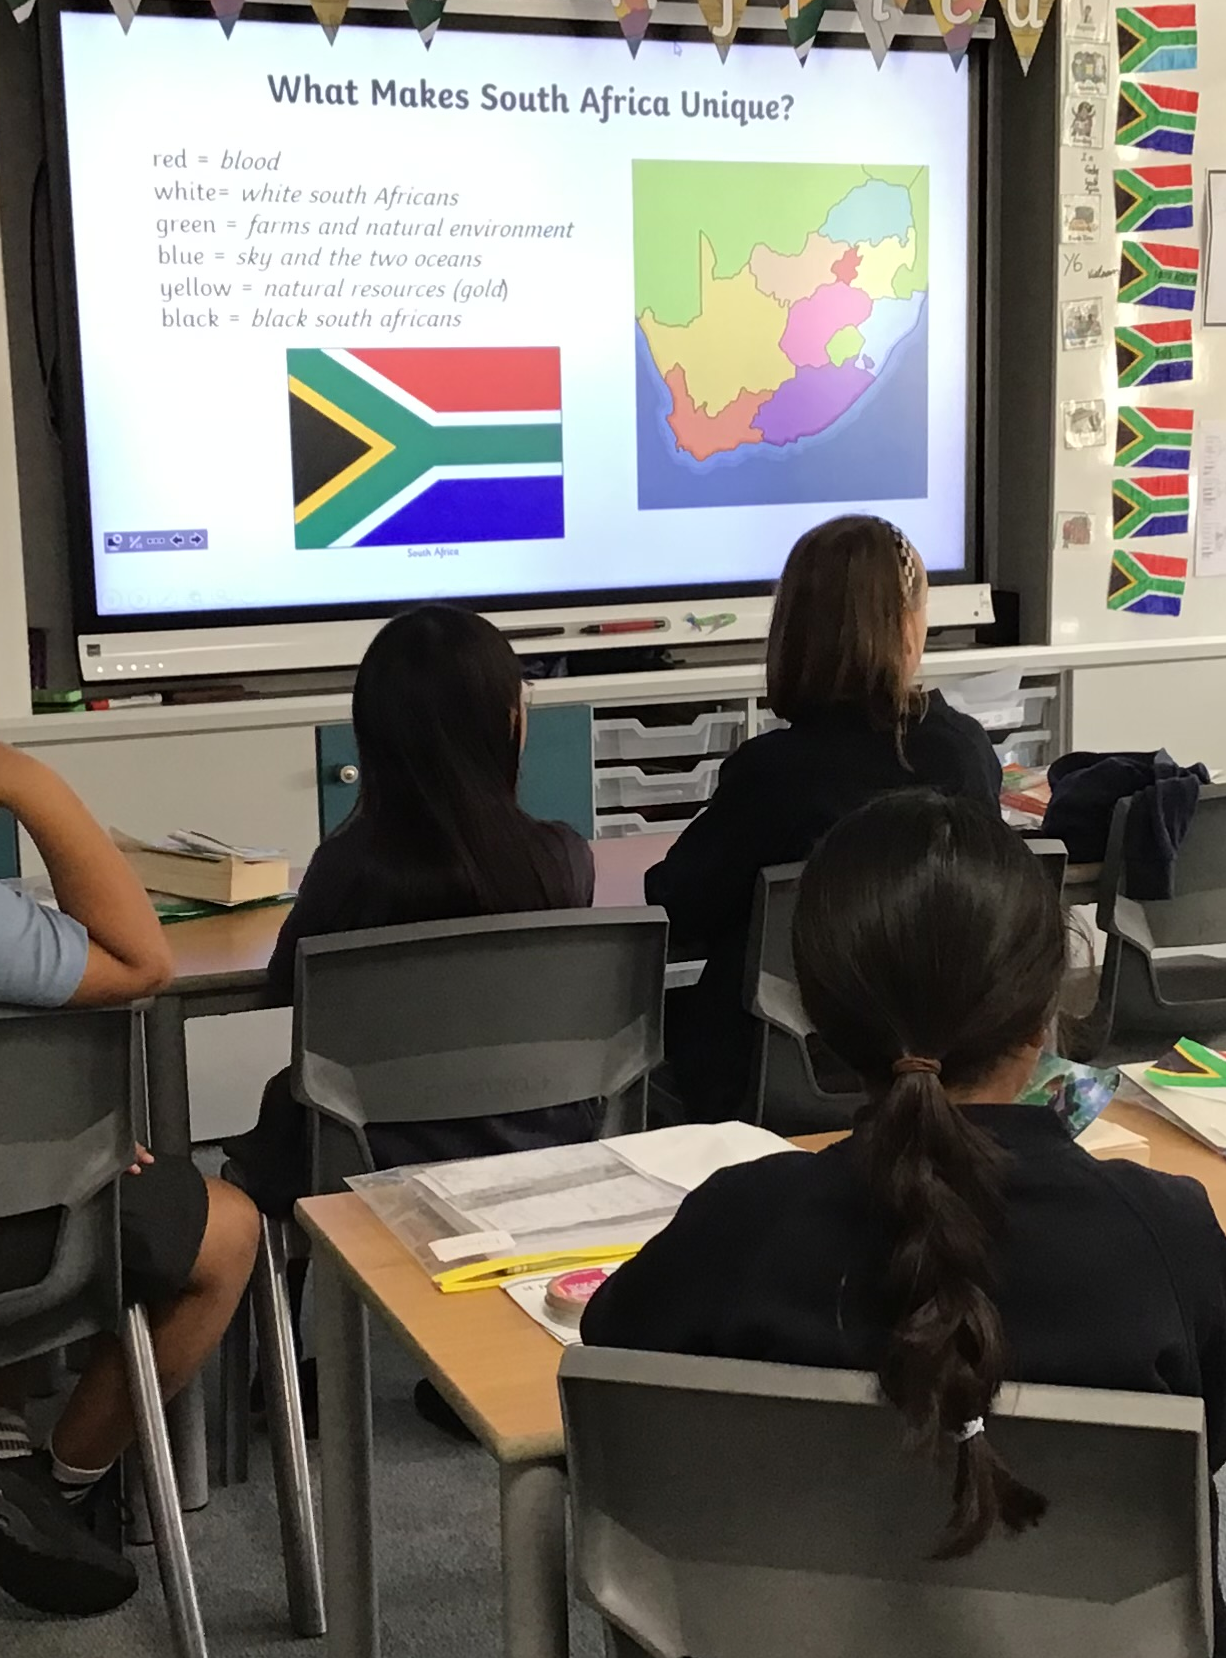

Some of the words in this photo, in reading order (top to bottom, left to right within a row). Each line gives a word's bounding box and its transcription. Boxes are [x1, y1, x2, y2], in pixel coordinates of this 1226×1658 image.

[267, 73, 359, 106] What
[371, 78, 469, 110] Makes
[481, 83, 570, 114] South
[580, 85, 670, 124] Africa
[681, 90, 794, 127] Unique?
[153, 148, 188, 169] red
[198, 155, 209, 164] =
[220, 149, 282, 171] blood
[242, 183, 303, 203] white
[308, 185, 367, 205] south
[373, 186, 460, 212] Africans
[156, 217, 217, 238] green
[226, 220, 237, 228] =
[244, 214, 311, 240] farms
[318, 216, 360, 236] and
[365, 218, 444, 237] natural
[449, 219, 575, 239] environment
[158, 245, 204, 265] blue
[214, 252, 225, 260] =
[236, 246, 273, 272] sky
[280, 247, 323, 267] and
[329, 247, 362, 267] the
[369, 251, 408, 267] two
[414, 254, 482, 268] oceans
[1063, 253, 1083, 277] Y6
[160, 277, 232, 303] yellow
[264, 278, 345, 298] natural
[351, 282, 446, 298] resources
[452, 279, 508, 304] (gold)
[161, 308, 220, 328] black
[229, 314, 240, 322] =
[251, 308, 308, 328] black
[314, 309, 372, 328] south
[380, 308, 462, 333] africans
[407, 547, 431, 558] South
[434, 546, 460, 559] Africa
